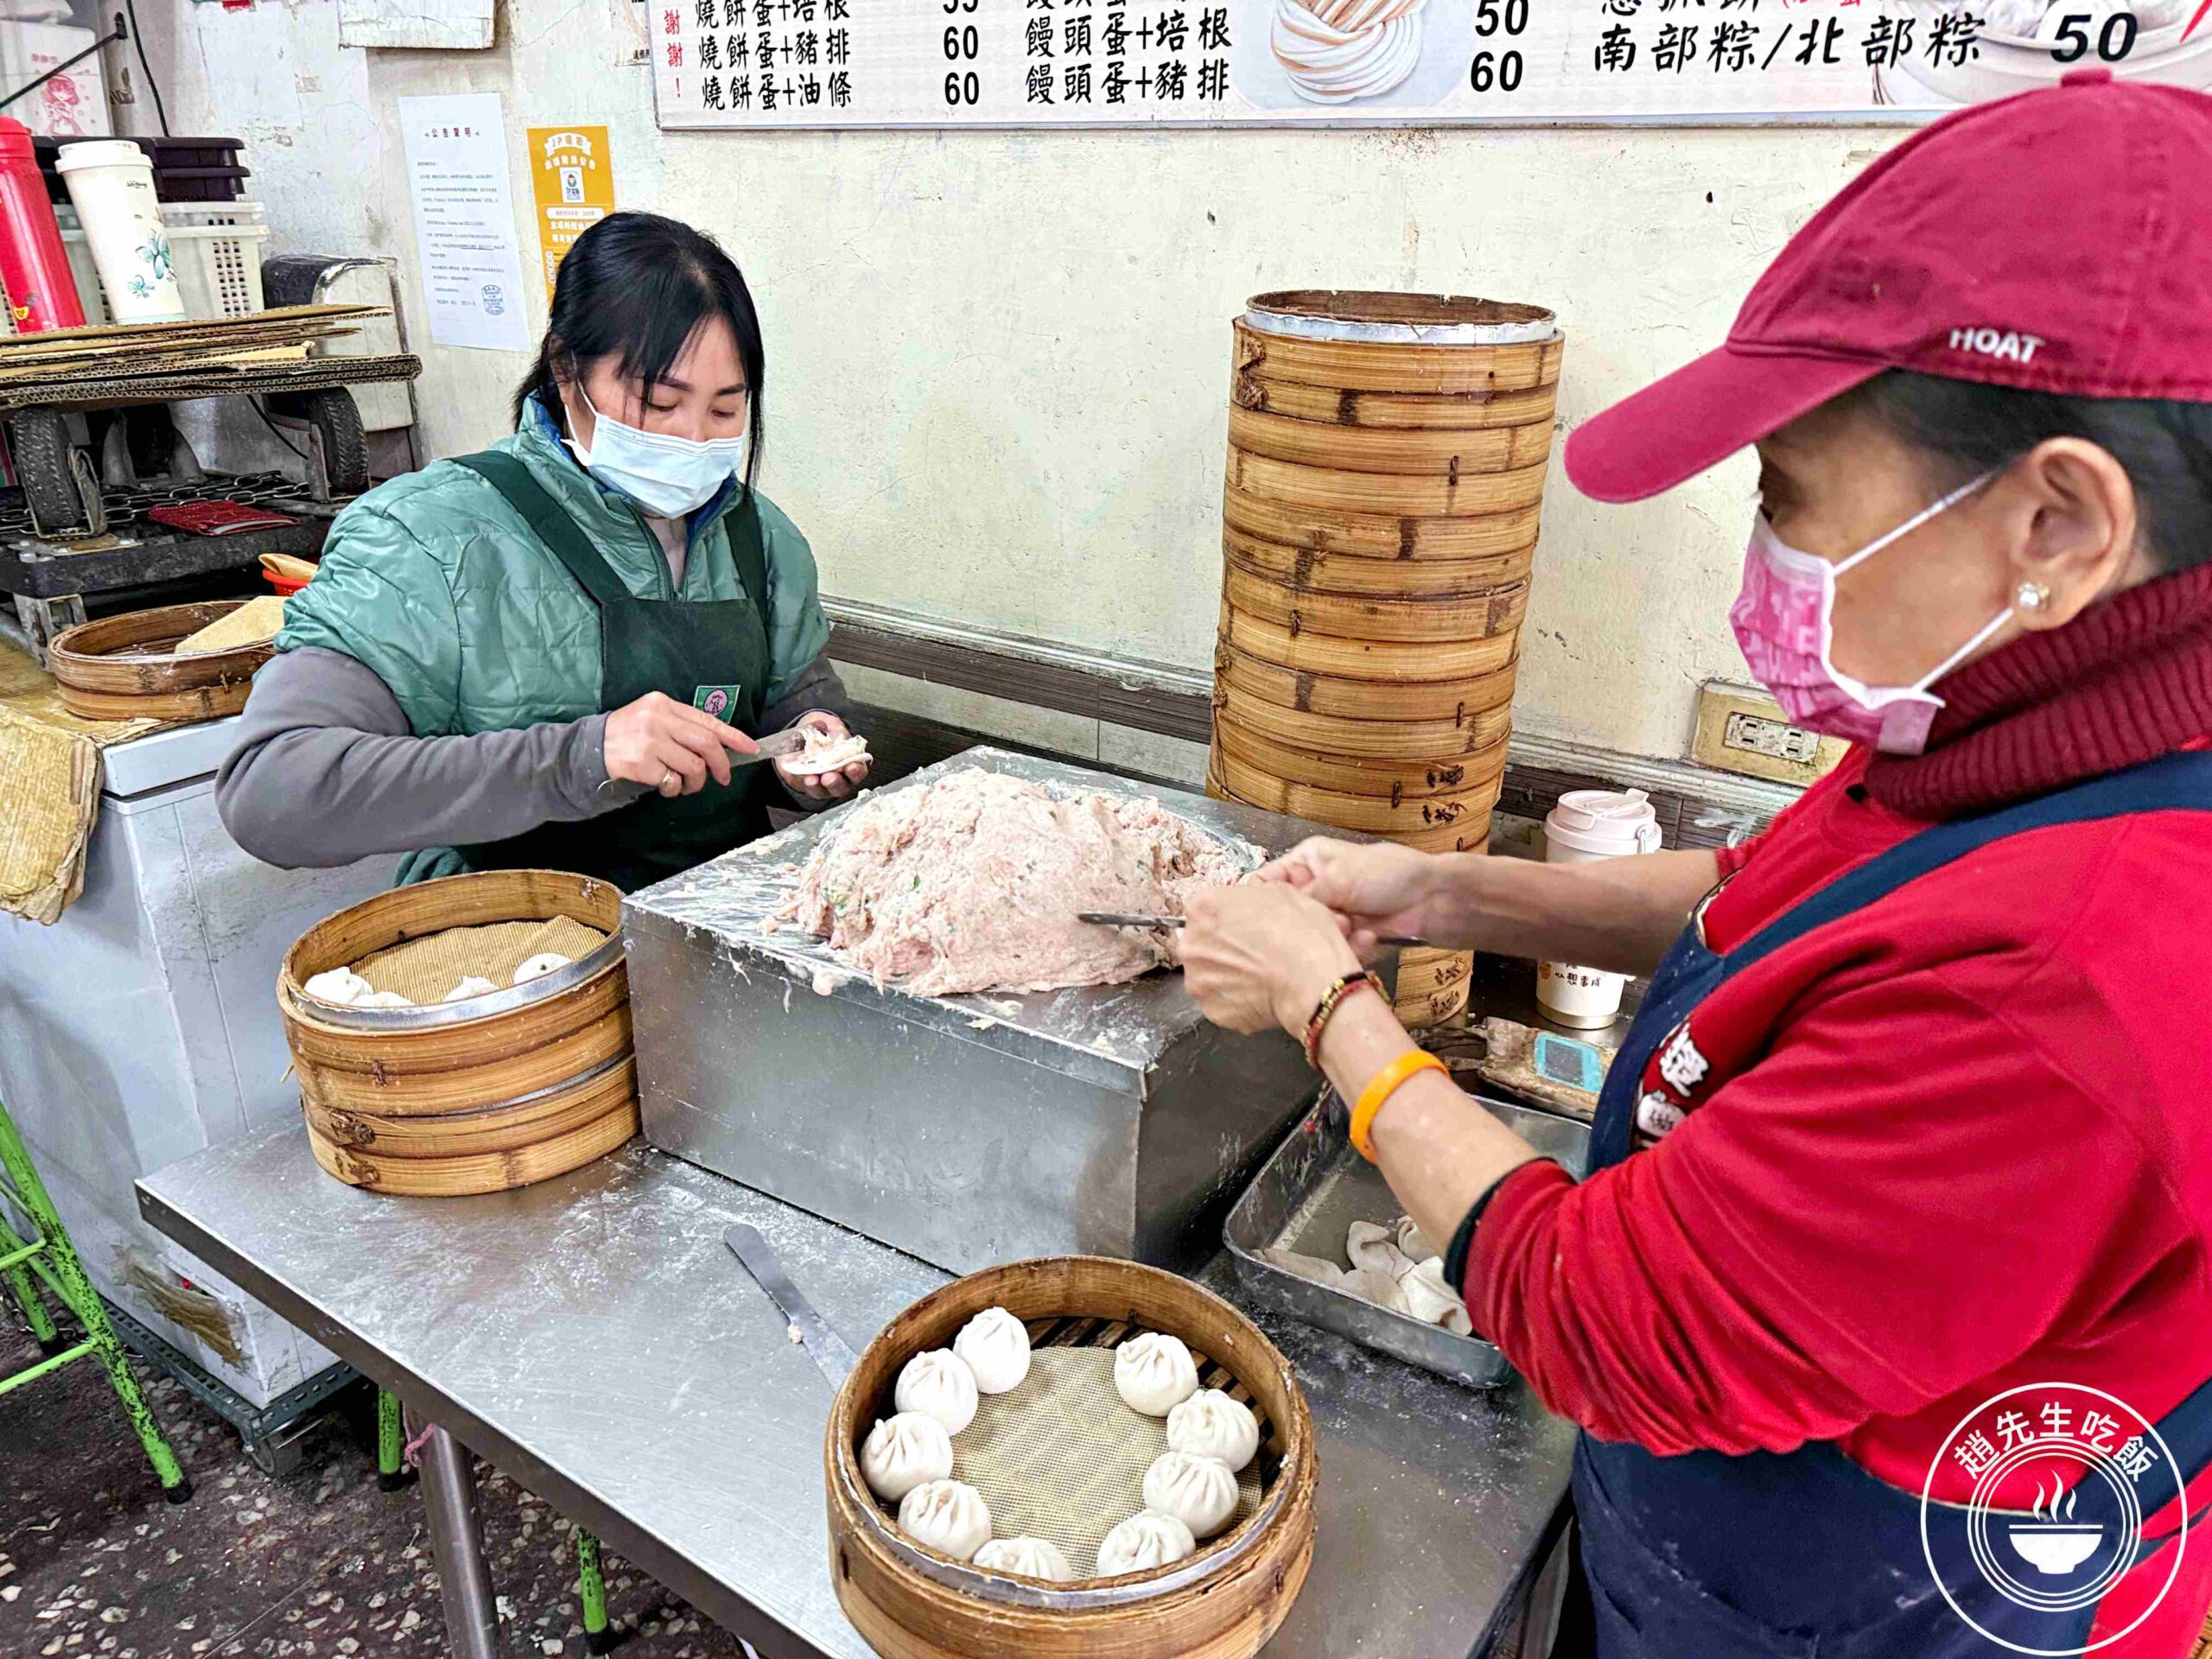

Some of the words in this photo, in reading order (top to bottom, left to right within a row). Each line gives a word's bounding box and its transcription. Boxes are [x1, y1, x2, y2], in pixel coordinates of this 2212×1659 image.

[1025, 7, 1233, 58] 饅頭蛋+培根
[1474, 0, 1529, 36] 50
[2050, 11, 2139, 63] 50
[698, 27, 851, 70] 燒餅蛋+豬排
[943, 25, 979, 60] 60
[1594, 11, 1986, 74] 南部粽/北部粽
[702, 71, 853, 111] 燒餅蛋+油條
[944, 71, 980, 105] 60
[1025, 58, 1230, 105] 饅頭蛋+豬排
[1470, 50, 1523, 92] 60
[1948, 327, 2045, 364] HOAT
[1554, 971, 1602, 988] 心想事成
